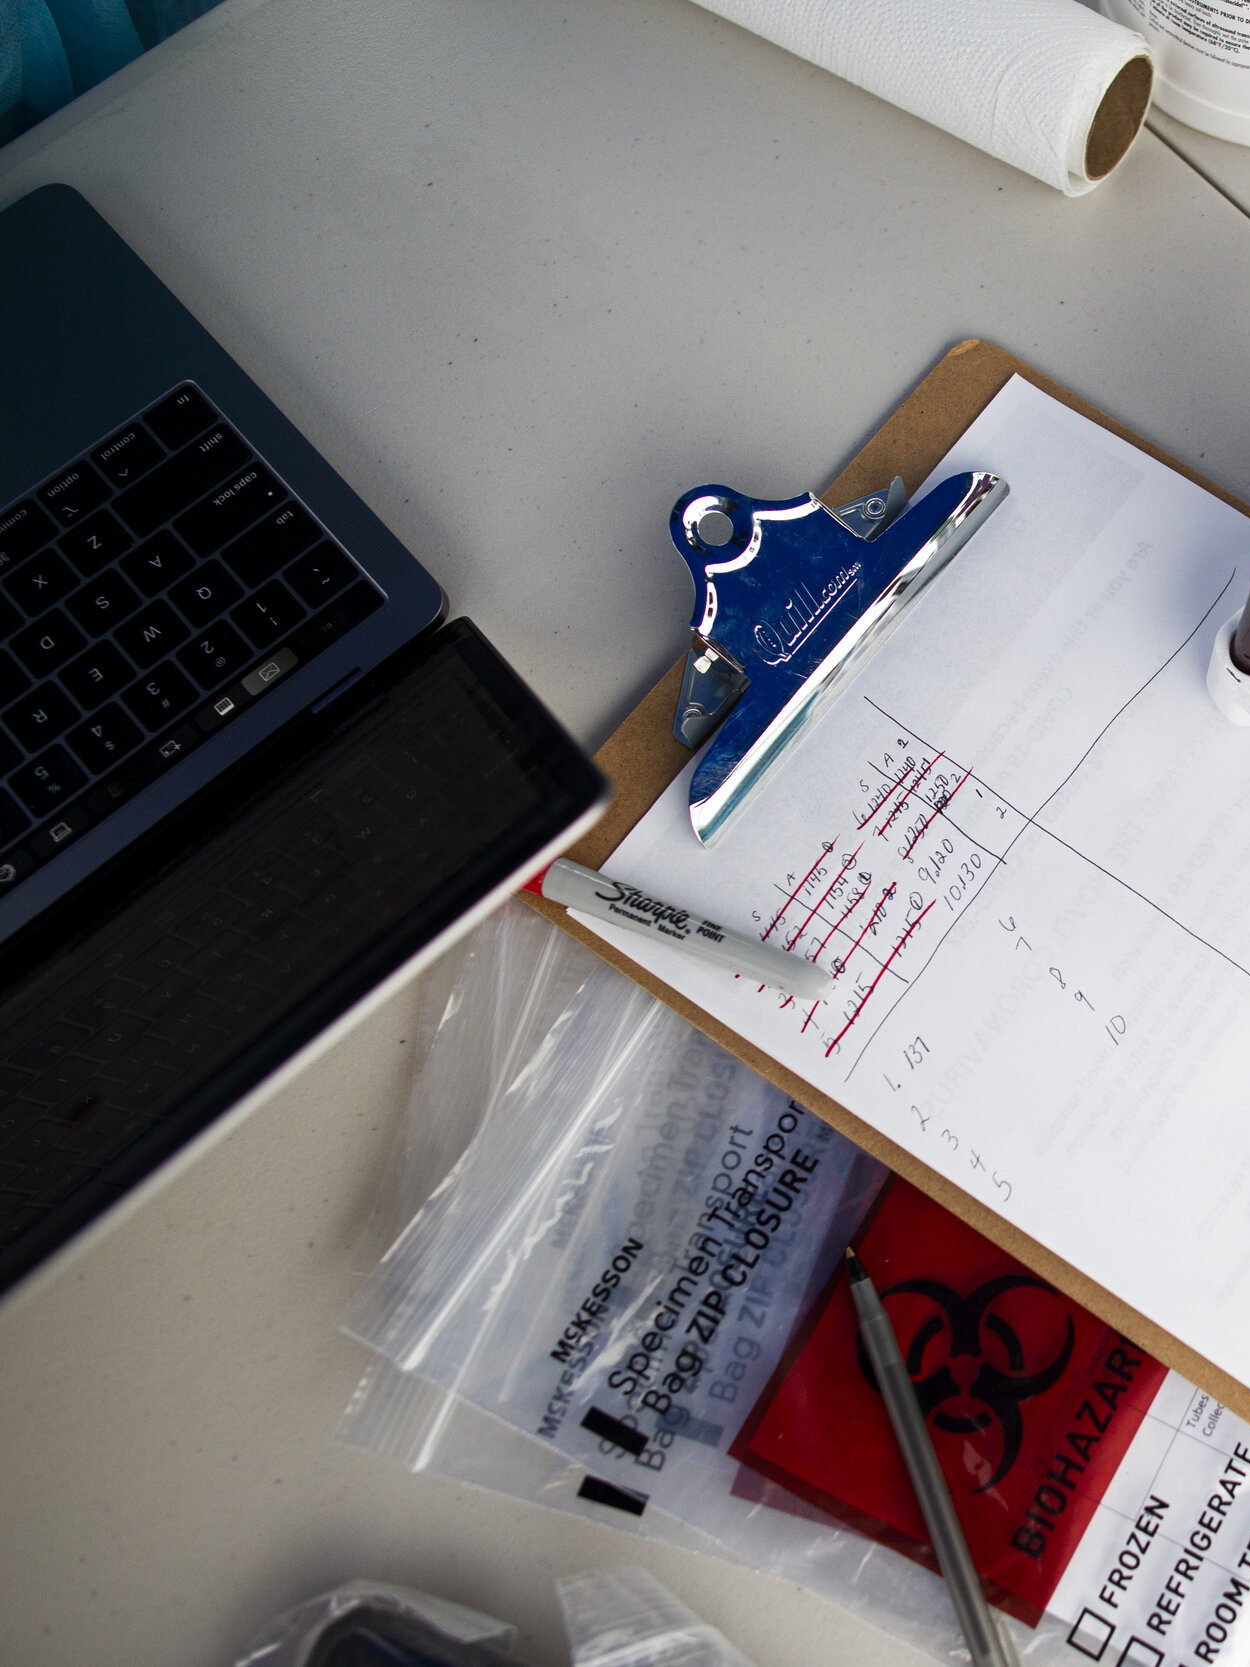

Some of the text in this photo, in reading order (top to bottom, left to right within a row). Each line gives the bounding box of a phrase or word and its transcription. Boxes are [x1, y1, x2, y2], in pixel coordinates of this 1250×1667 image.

[1220, 11, 1236, 20] PRIOR
[176, 394, 190, 405] fn
[101, 432, 136, 461] control
[199, 433, 223, 453] shift
[47, 473, 80, 498] option
[212, 472, 257, 507] caps lock
[275, 510, 294, 525] tab
[86, 535, 103, 550] Z
[148, 555, 162, 568] A
[32, 574, 48, 590] X
[196, 586, 212, 600] Q
[95, 596, 110, 609] S
[40, 635, 56, 649] D
[142, 626, 162, 643] W
[200, 641, 215, 654] 2
[88, 667, 104, 683] E
[1226, 667, 1241, 683] 1
[146, 682, 161, 695] 3
[32, 709, 48, 723] R
[90, 725, 103, 738] 4
[883, 753, 894, 767] A
[34, 766, 50, 780] 5
[997, 806, 1007, 819] 2
[786, 872, 796, 886] A
[594, 881, 690, 930] Sharpie
[608, 903, 686, 941] Permanent Marker
[701, 920, 723, 931] FINE
[696, 926, 726, 944] POINT
[1015, 936, 1032, 951] 7
[1049, 967, 1066, 989] 8
[1074, 990, 1095, 1011] 9
[1105, 1015, 1126, 1046] 10
[911, 1105, 930, 1132] 2
[942, 1129, 958, 1150] 3
[970, 1149, 986, 1172] 4
[992, 1170, 1012, 1202] 5
[608, 1234, 723, 1396] Specimen
[707, 1100, 805, 1230] Transpor
[641, 1350, 704, 1415] Bag
[686, 1291, 727, 1345] ZIP
[721, 1149, 819, 1287] CLOSURE
[1185, 1393, 1210, 1429] Tubes
[1202, 1401, 1226, 1437] Collec
[1099, 1494, 1170, 1609] FROZEN
[1194, 1577, 1250, 1665] ROOM
